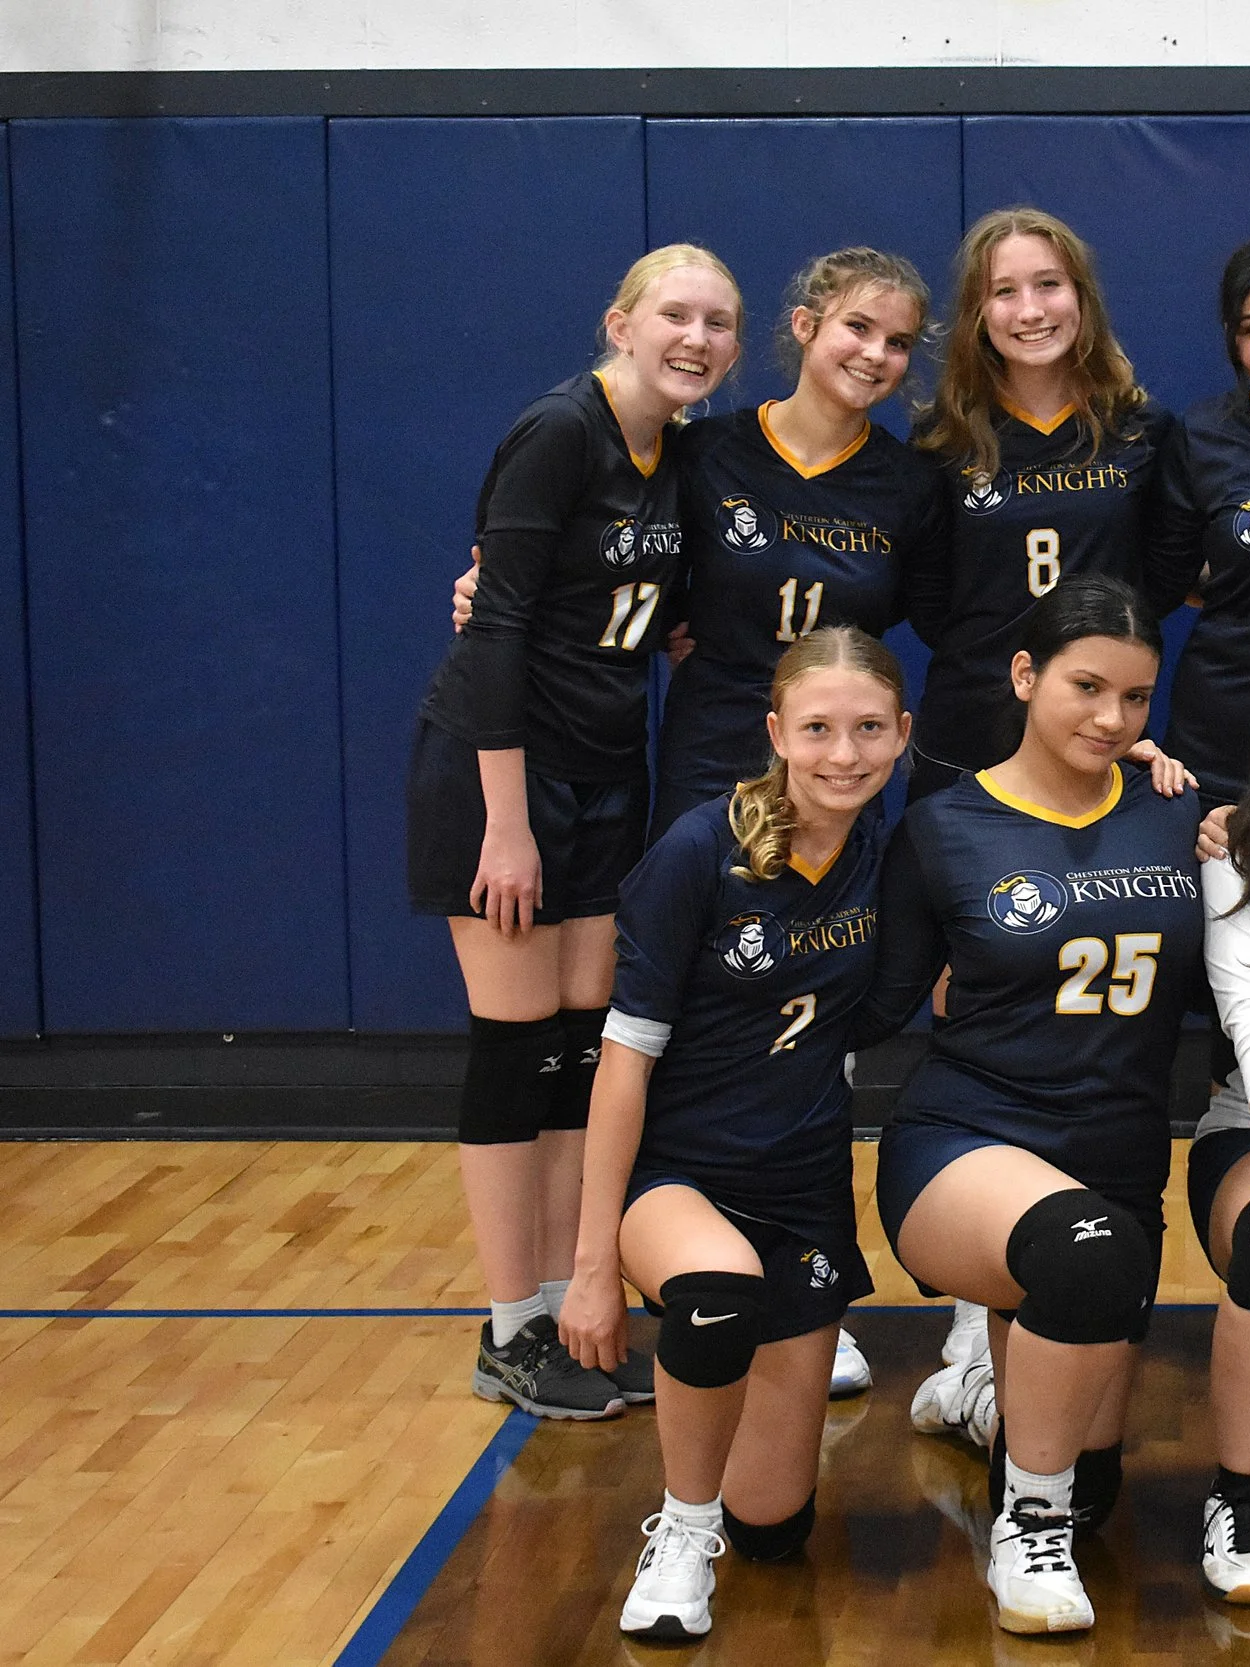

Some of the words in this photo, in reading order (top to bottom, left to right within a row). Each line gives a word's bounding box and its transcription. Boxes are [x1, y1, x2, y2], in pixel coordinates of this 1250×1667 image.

[1016, 464, 1128, 495] KNIGHTS
[782, 518, 892, 554] KNIGHTS
[1026, 528, 1061, 599] 8
[598, 582, 661, 651] 17
[775, 577, 824, 643] 11
[1065, 867, 1131, 880] CHESTERTON
[1132, 865, 1173, 873] ACADEMY
[1068, 869, 1198, 903] KNIGHTS
[1055, 932, 1162, 1016] 25
[769, 993, 816, 1056] 2
